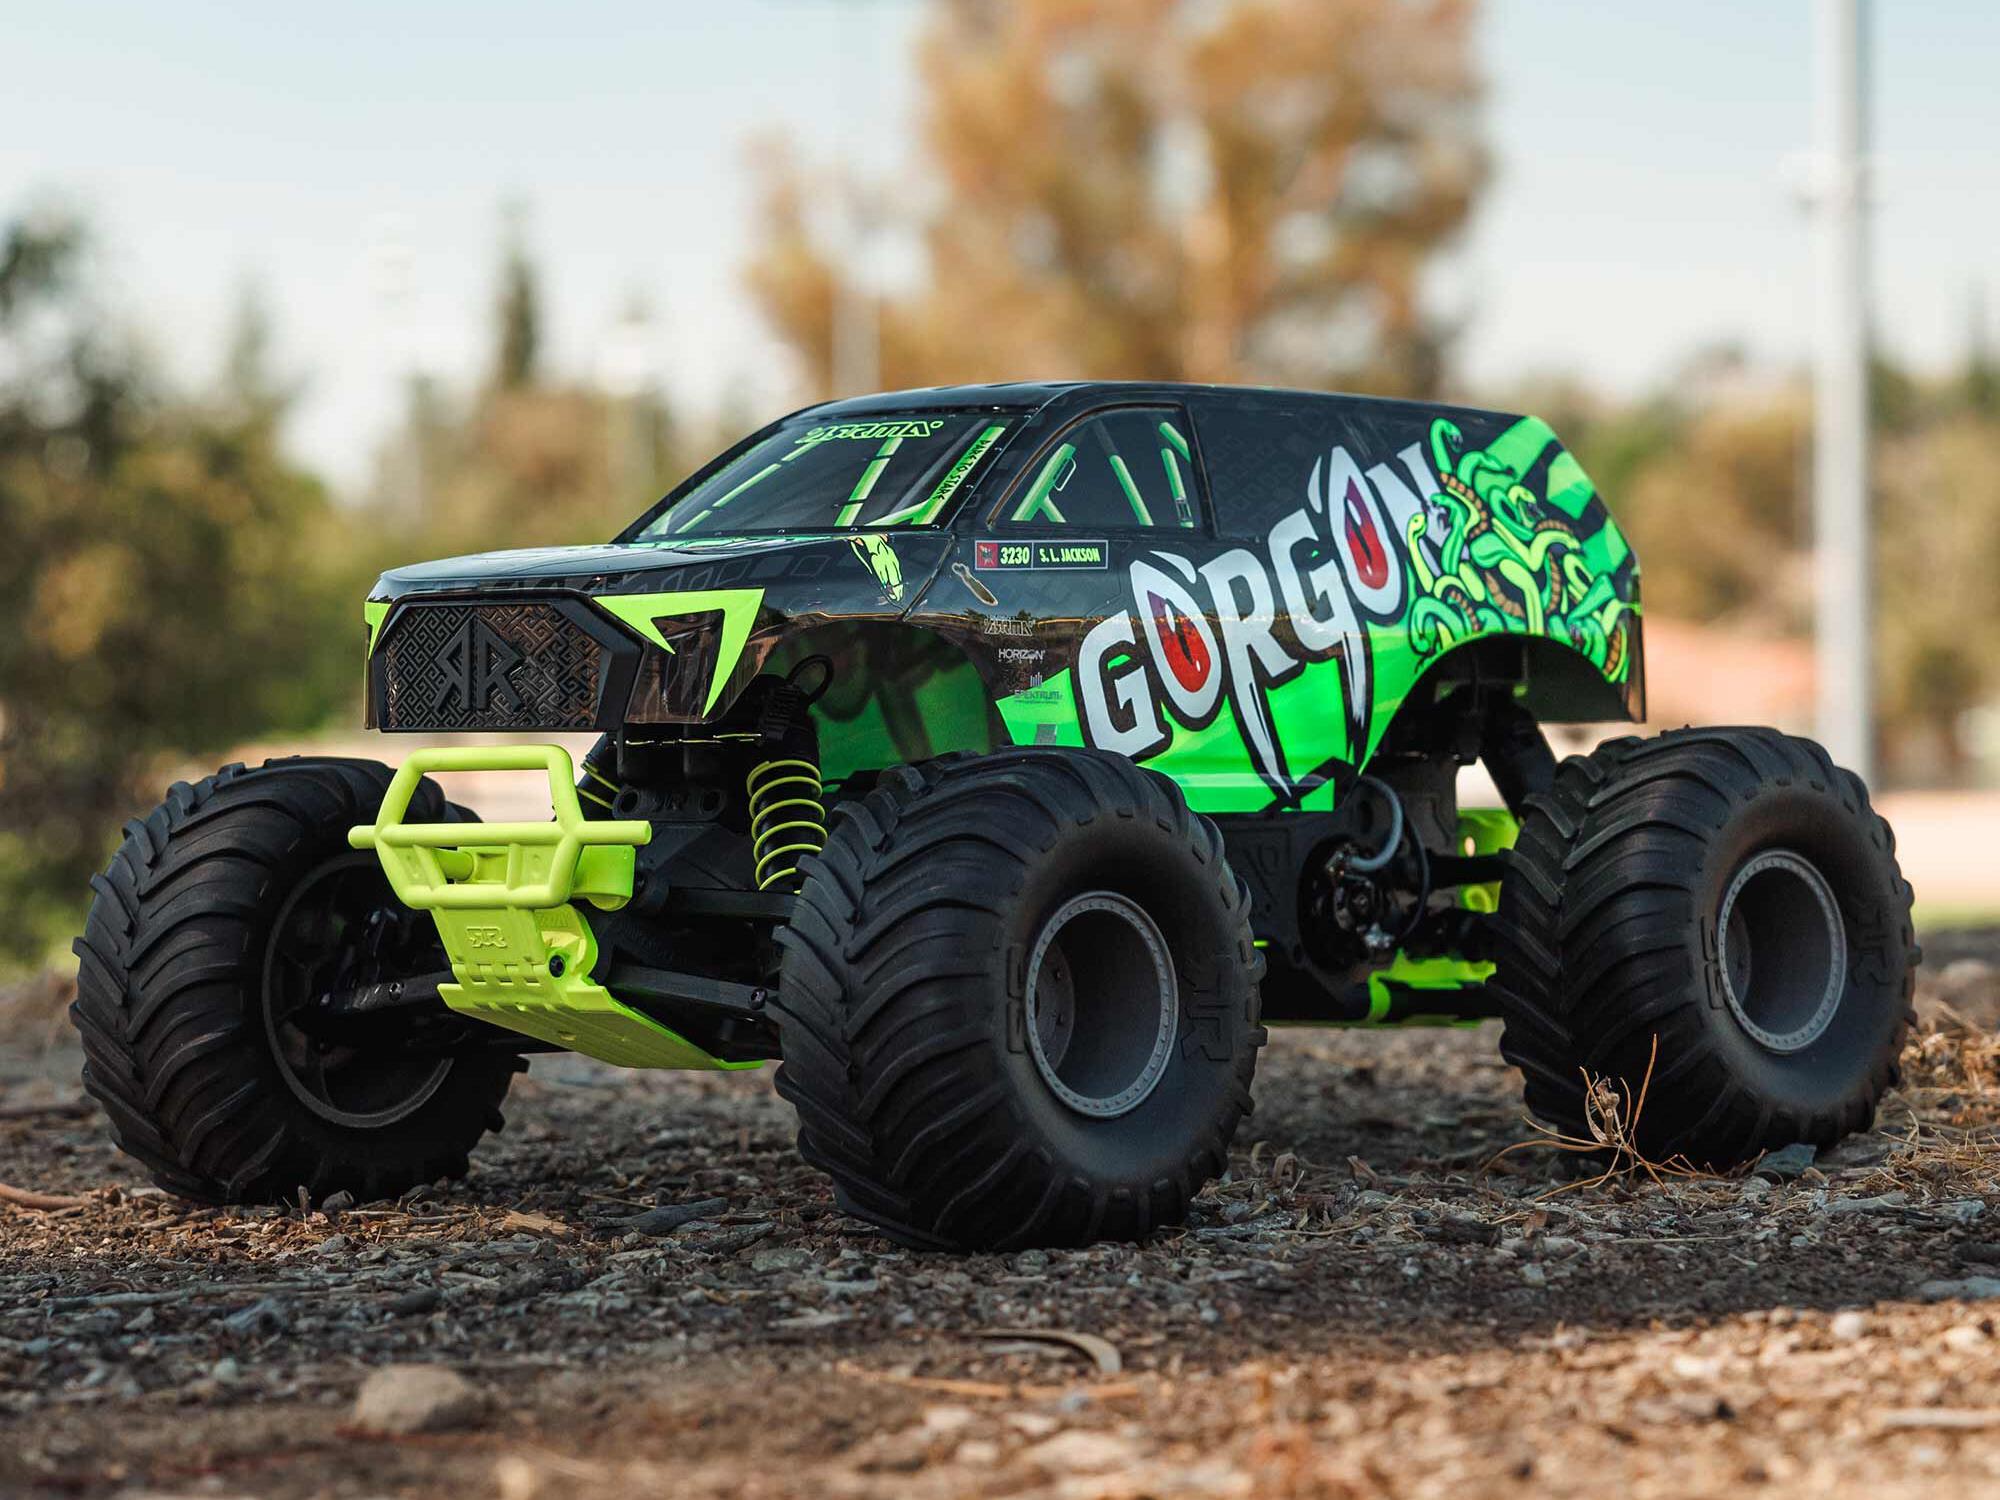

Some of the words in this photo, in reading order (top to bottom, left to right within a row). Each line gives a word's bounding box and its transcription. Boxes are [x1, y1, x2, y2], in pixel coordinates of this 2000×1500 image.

[1000, 546, 1030, 564] 3230
[1061, 548, 1101, 563] JACKSON
[1078, 441, 1464, 797] GORGON
[998, 648, 1045, 660] HORIZON
